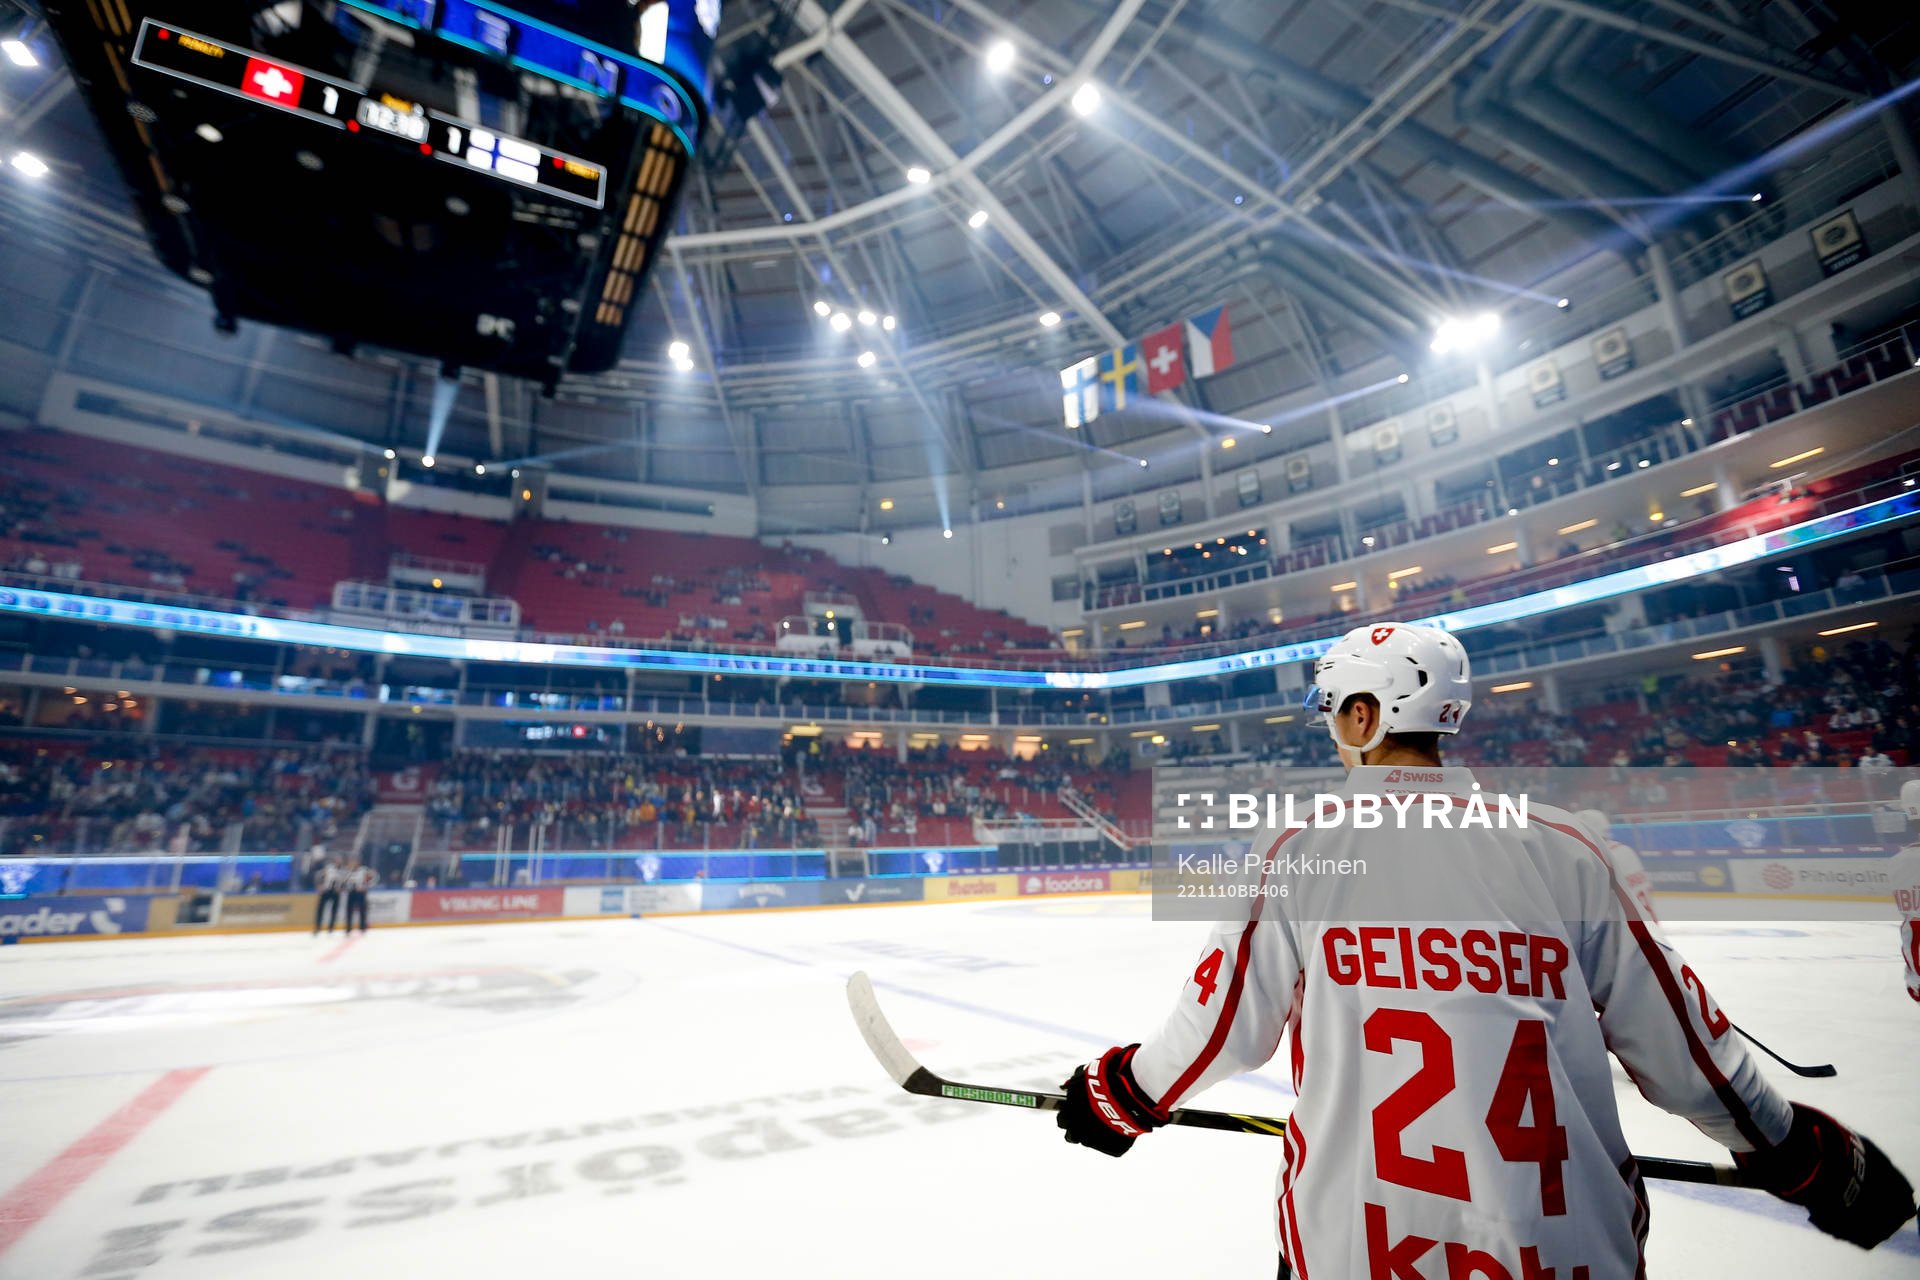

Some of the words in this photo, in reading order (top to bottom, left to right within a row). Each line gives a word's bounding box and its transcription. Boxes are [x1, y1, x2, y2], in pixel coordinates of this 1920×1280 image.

[322, 85, 339, 115] 1
[446, 126, 462, 154] 1
[1403, 772, 1444, 783] SWISS
[1045, 876, 1104, 893] foodora
[439, 897, 499, 913] VIKING
[502, 895, 539, 911] LINE
[1323, 926, 1570, 1000] GEISSER
[1364, 1008, 1570, 1217] 24
